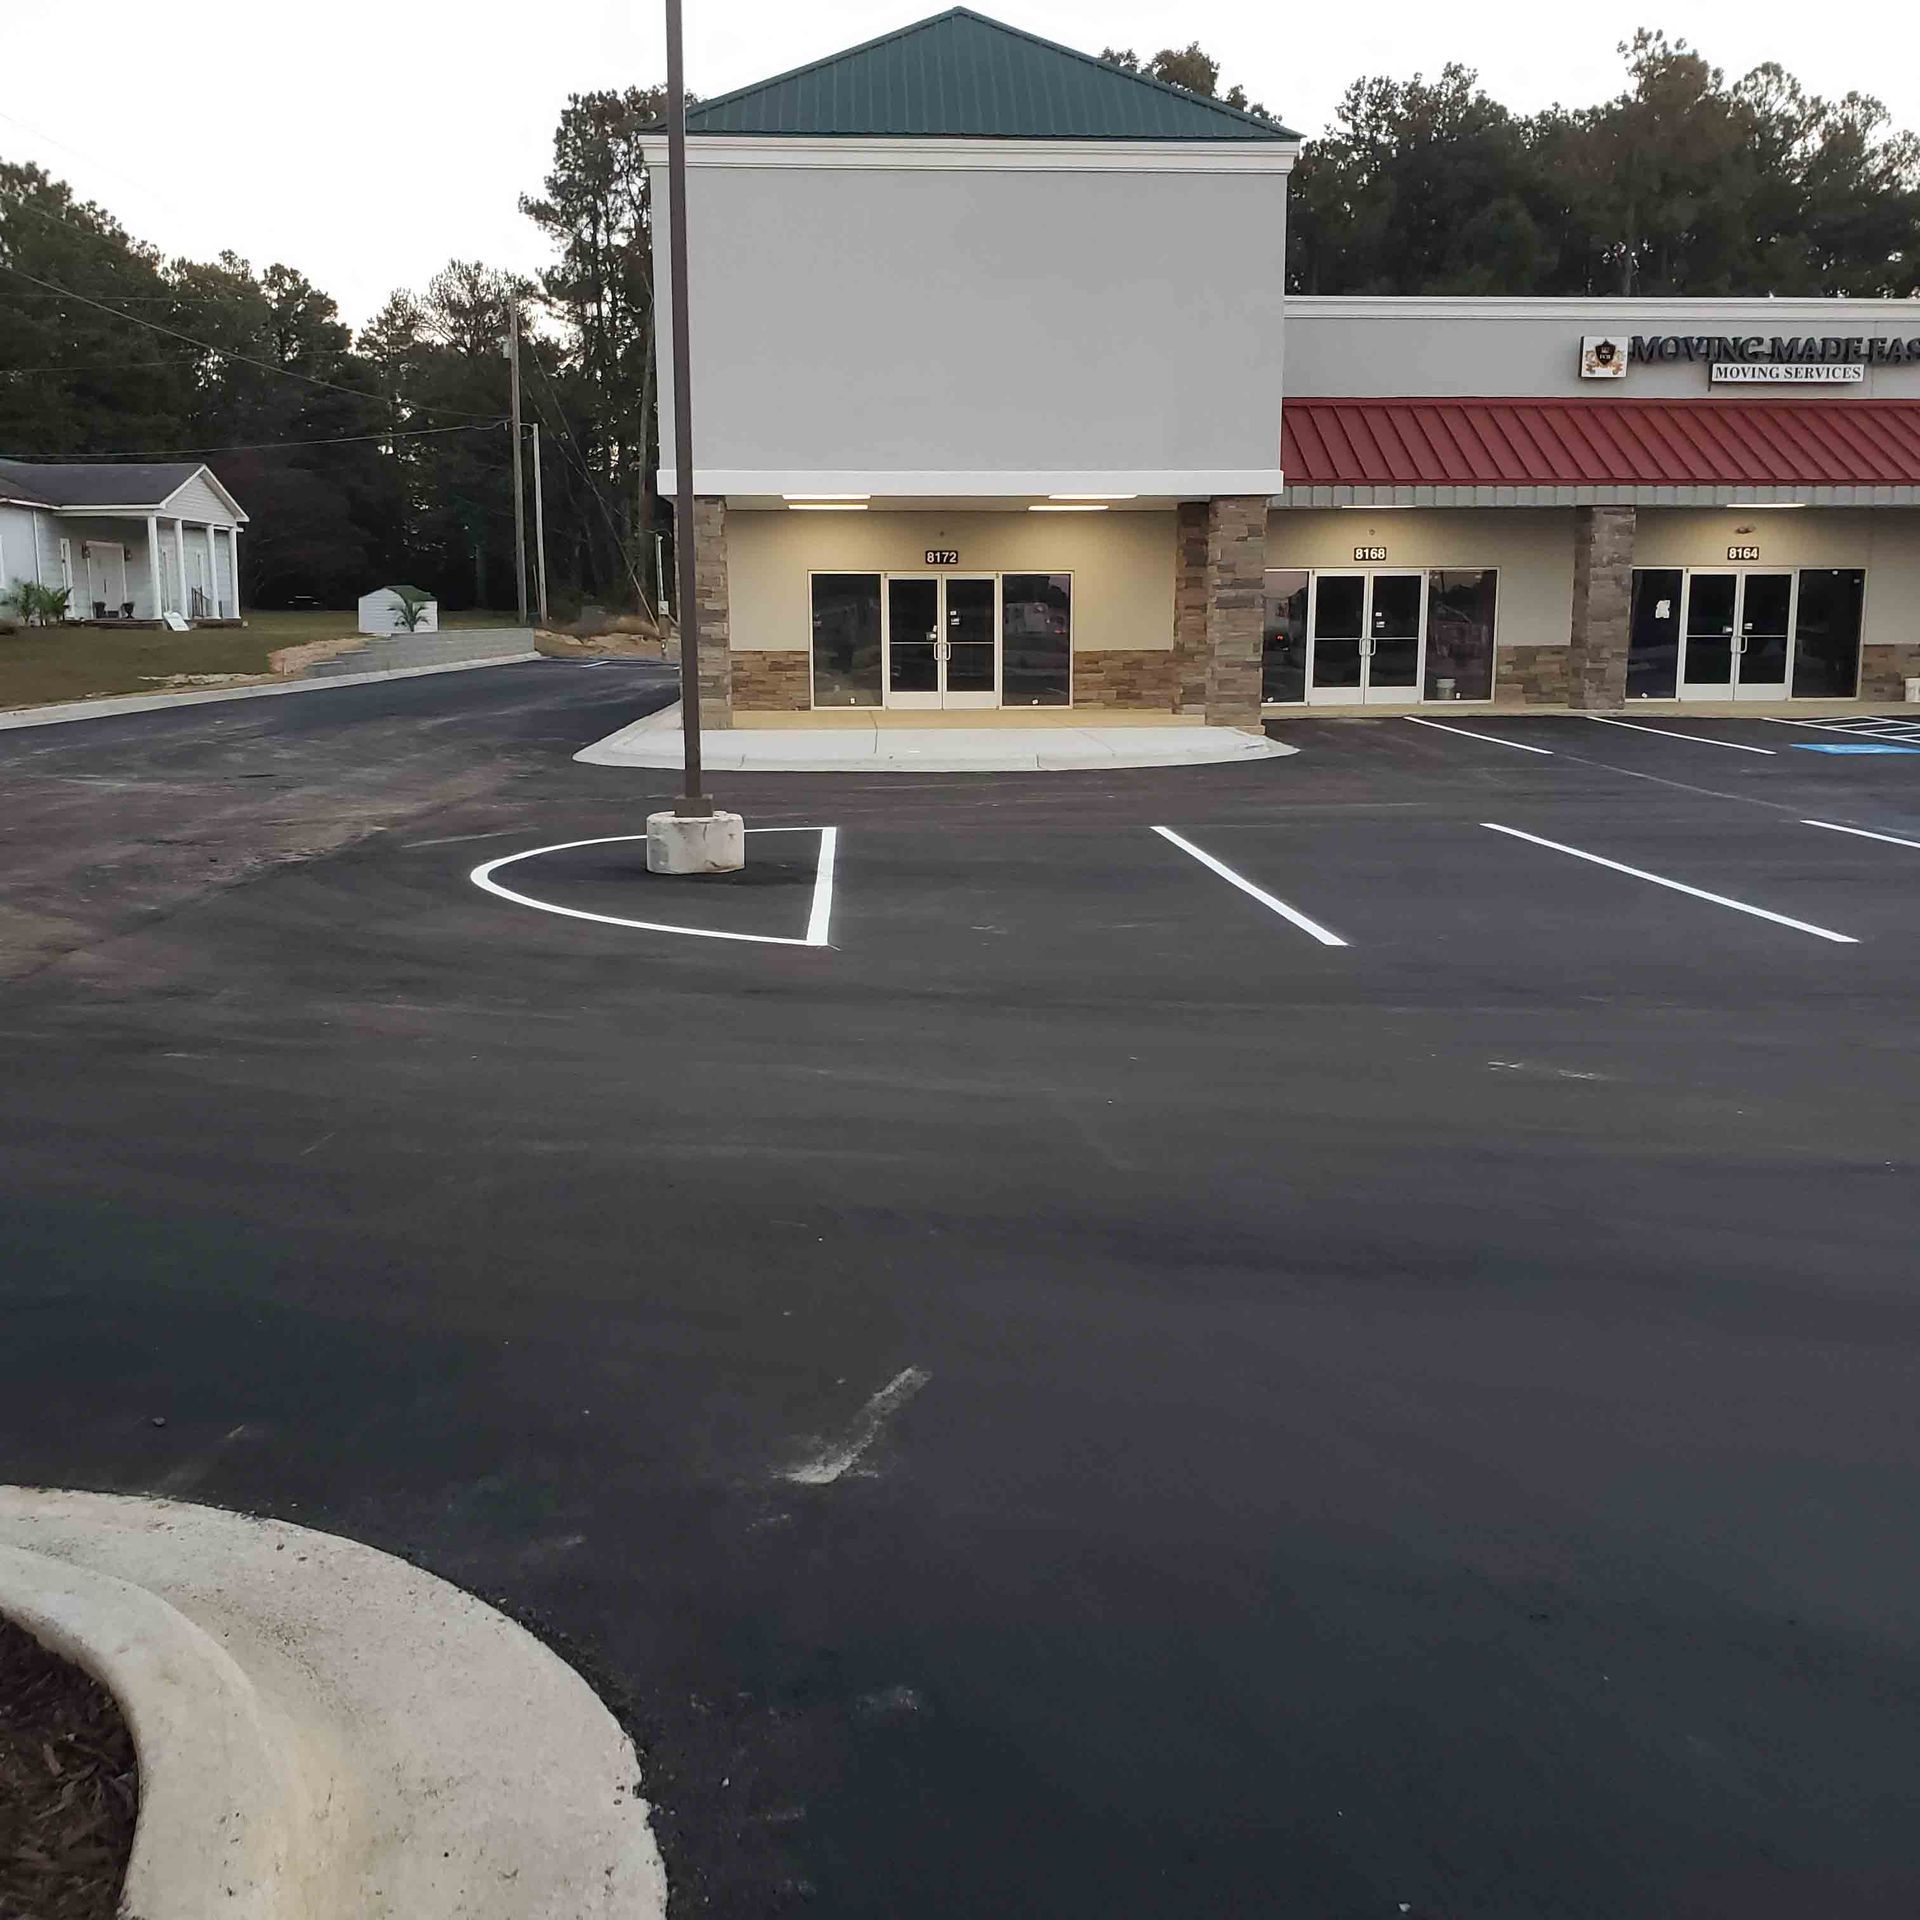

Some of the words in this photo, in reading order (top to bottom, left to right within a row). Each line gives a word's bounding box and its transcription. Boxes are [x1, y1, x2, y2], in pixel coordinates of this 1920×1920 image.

[1631, 336, 1765, 362] MOVING
[1769, 336, 1863, 362] MADE
[1715, 366, 1780, 379] MOVING
[1783, 366, 1861, 379] SERVICES
[927, 551, 957, 563] 8172
[1355, 548, 1385, 559] 8168
[1729, 547, 1757, 559] 8164
